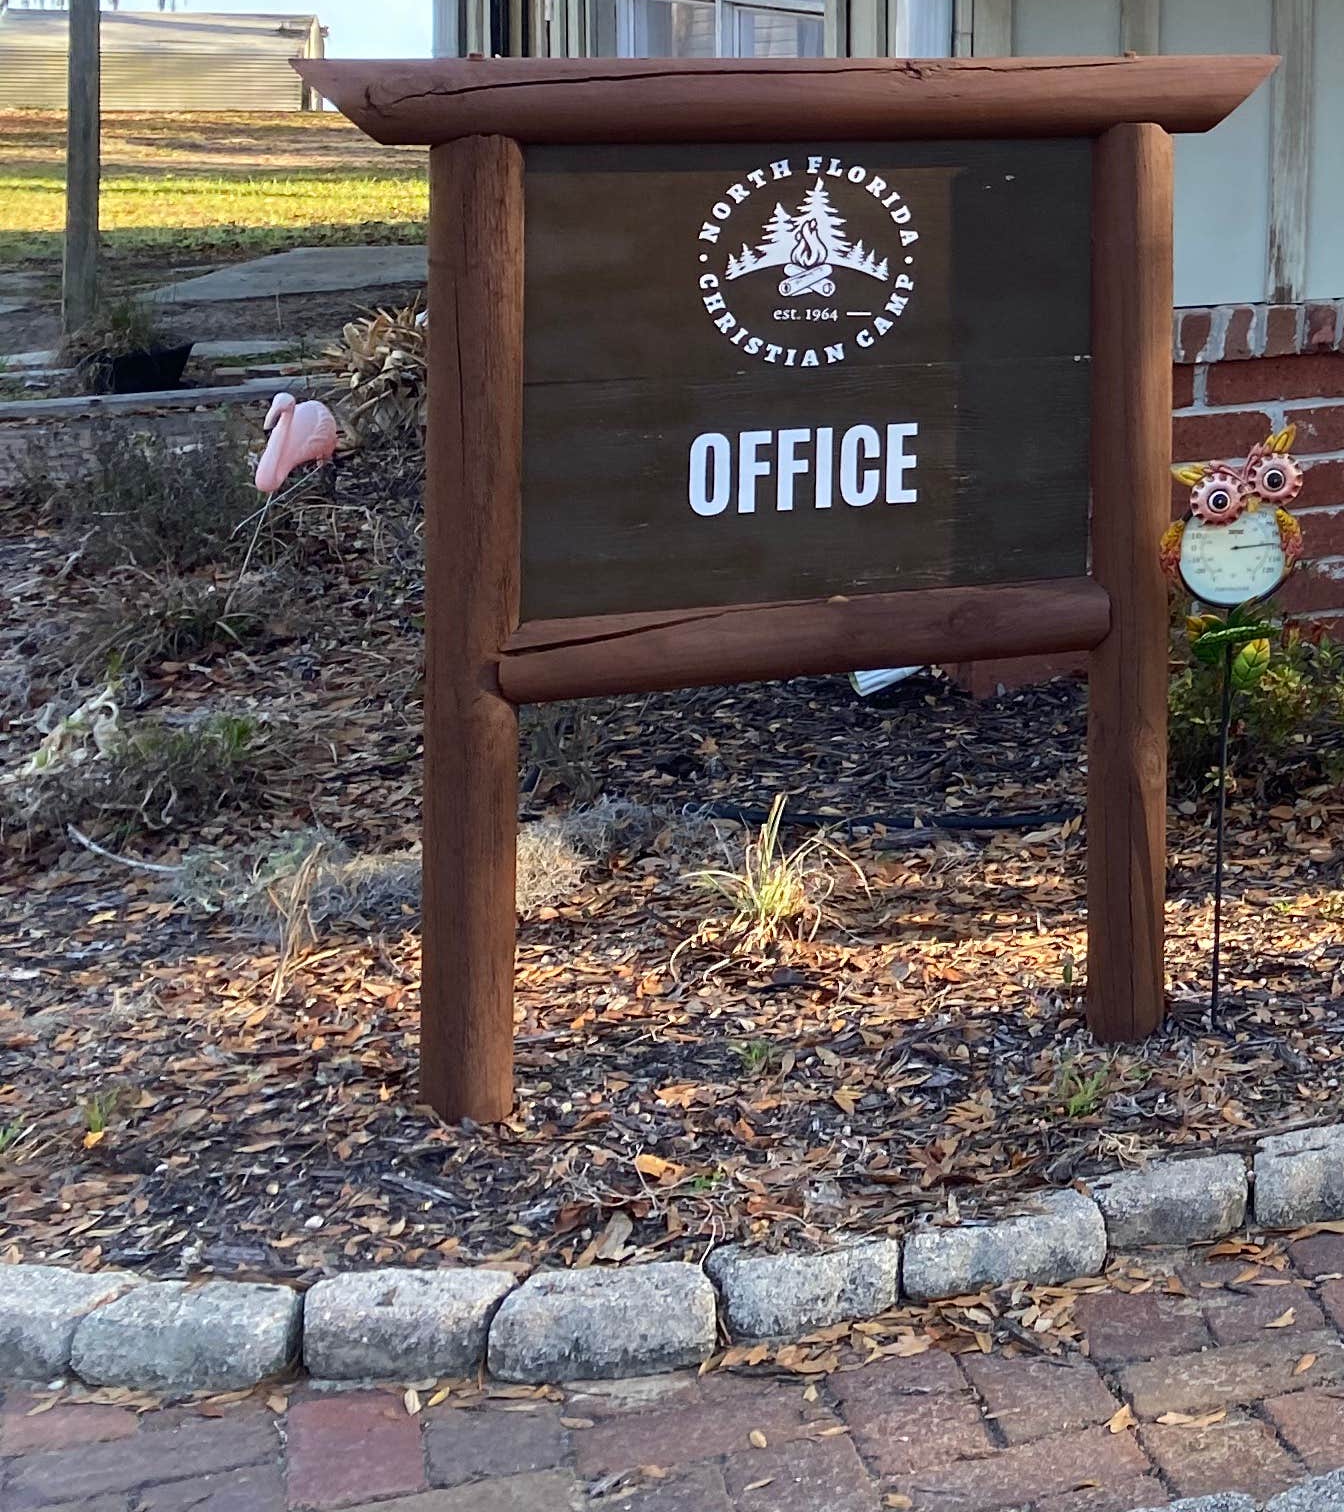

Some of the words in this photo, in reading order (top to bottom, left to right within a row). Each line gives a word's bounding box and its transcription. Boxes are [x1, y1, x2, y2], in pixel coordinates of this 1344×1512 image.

[699, 158, 792, 243] NORTH
[806, 156, 919, 246] FLORIDA
[699, 273, 845, 367] CHRISTIAN
[856, 273, 914, 348] CAMP
[773, 309, 801, 320] est.
[805, 308, 838, 321] 1964
[688, 422, 918, 516] OFFICE
